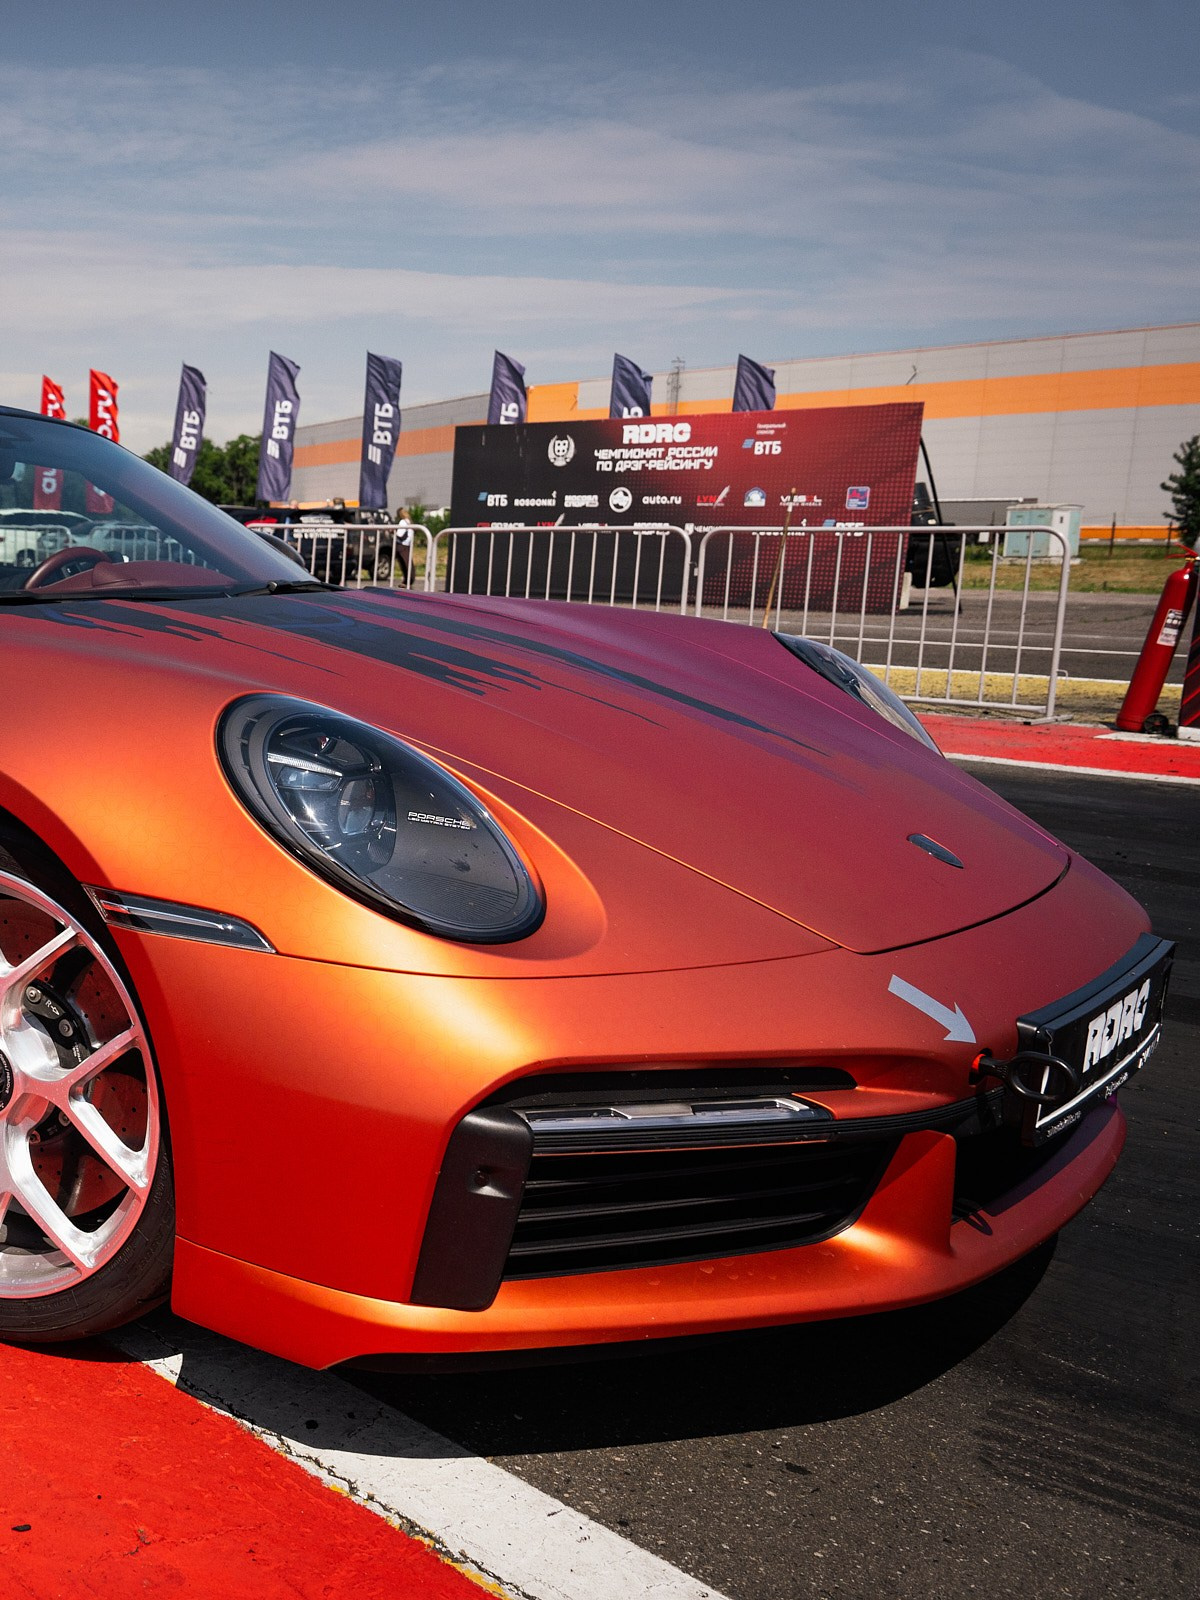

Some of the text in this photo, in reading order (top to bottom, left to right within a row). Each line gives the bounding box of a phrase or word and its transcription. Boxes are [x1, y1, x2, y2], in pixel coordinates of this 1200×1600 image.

[271, 400, 293, 440] ВТБ
[372, 402, 394, 445] ВТБ
[180, 410, 200, 450] ВТБ
[622, 422, 692, 444] RDRC
[594, 445, 718, 460] ЧЕМПИОНАТ РОССИИ
[754, 440, 782, 455] ВТБ
[596, 457, 713, 472] ПО ДРЭГ-РЕЙСИНГУ
[487, 494, 508, 507] ВТБ
[642, 495, 682, 504] auto.ru
[408, 811, 470, 827] PORSCHE
[1082, 978, 1151, 1073] RDRC
